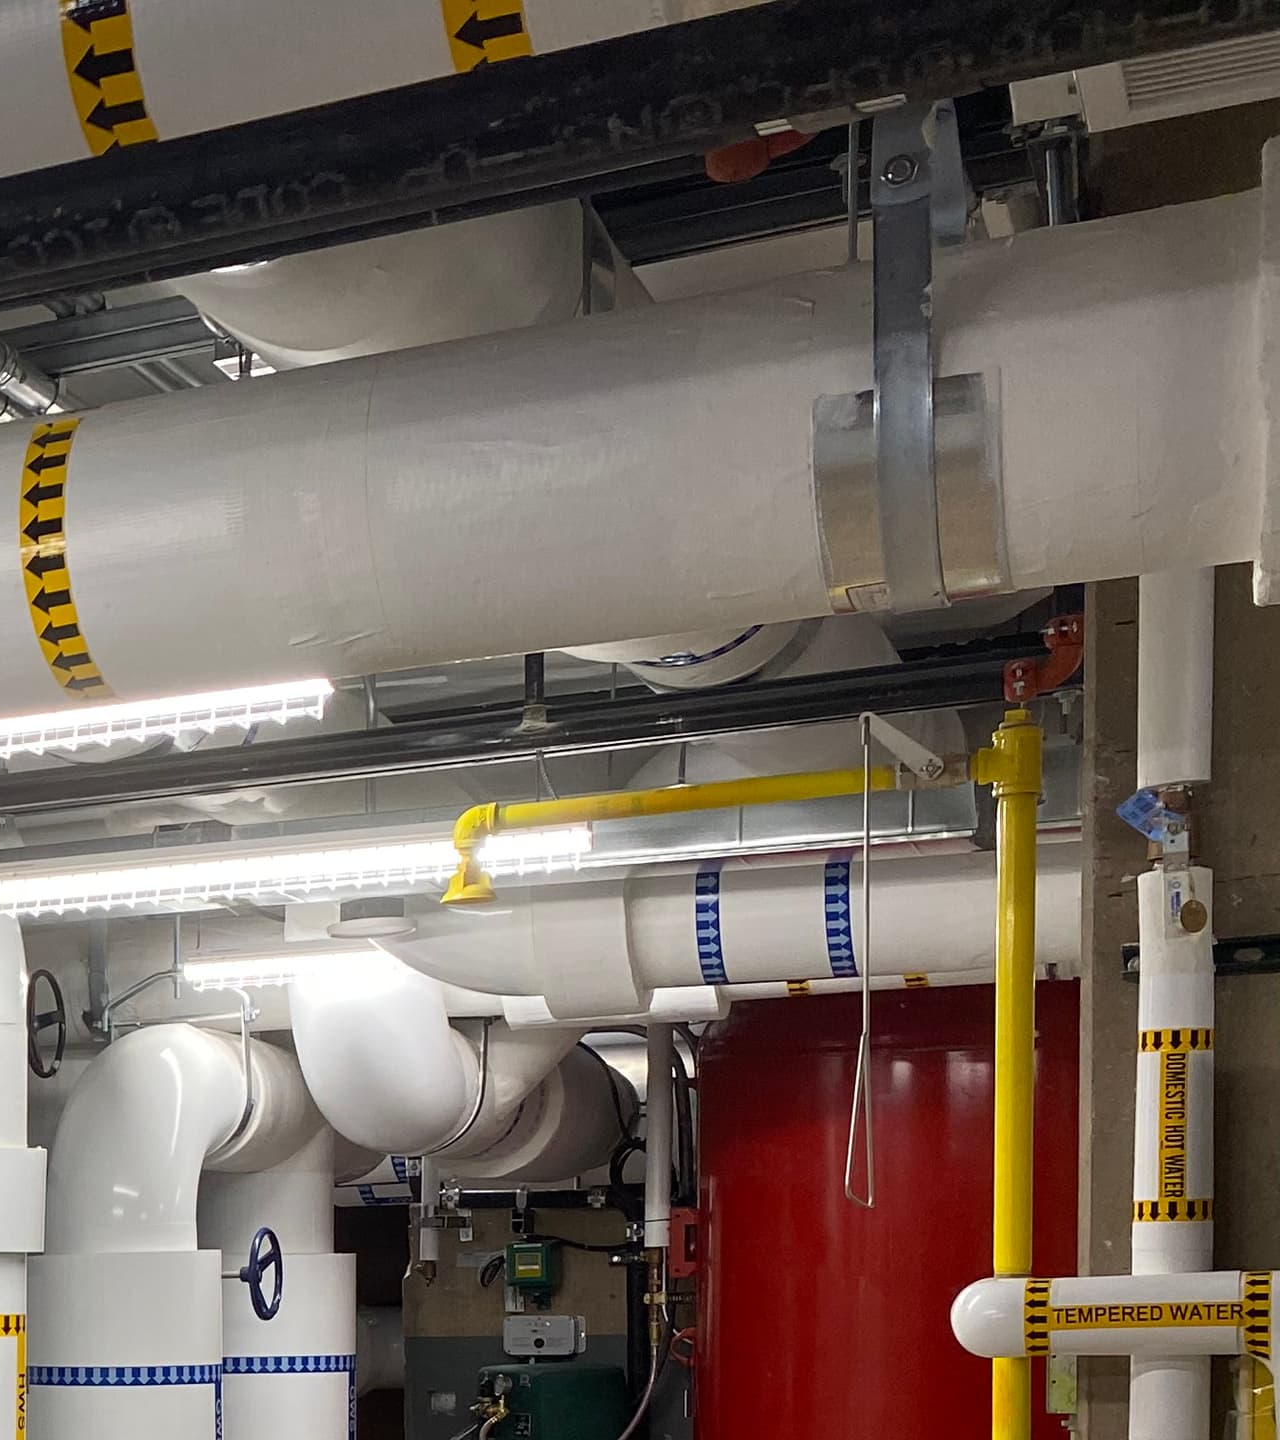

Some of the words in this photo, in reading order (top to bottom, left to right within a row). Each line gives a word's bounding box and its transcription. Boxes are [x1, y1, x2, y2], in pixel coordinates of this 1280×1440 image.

[1165, 1053, 1186, 1120] DOMESTIC
[1165, 1125, 1185, 1150] HOT
[1164, 1154, 1185, 1198] WATER
[1052, 1306, 1163, 1324] TEMPERED
[1169, 1303, 1245, 1321] WATER
